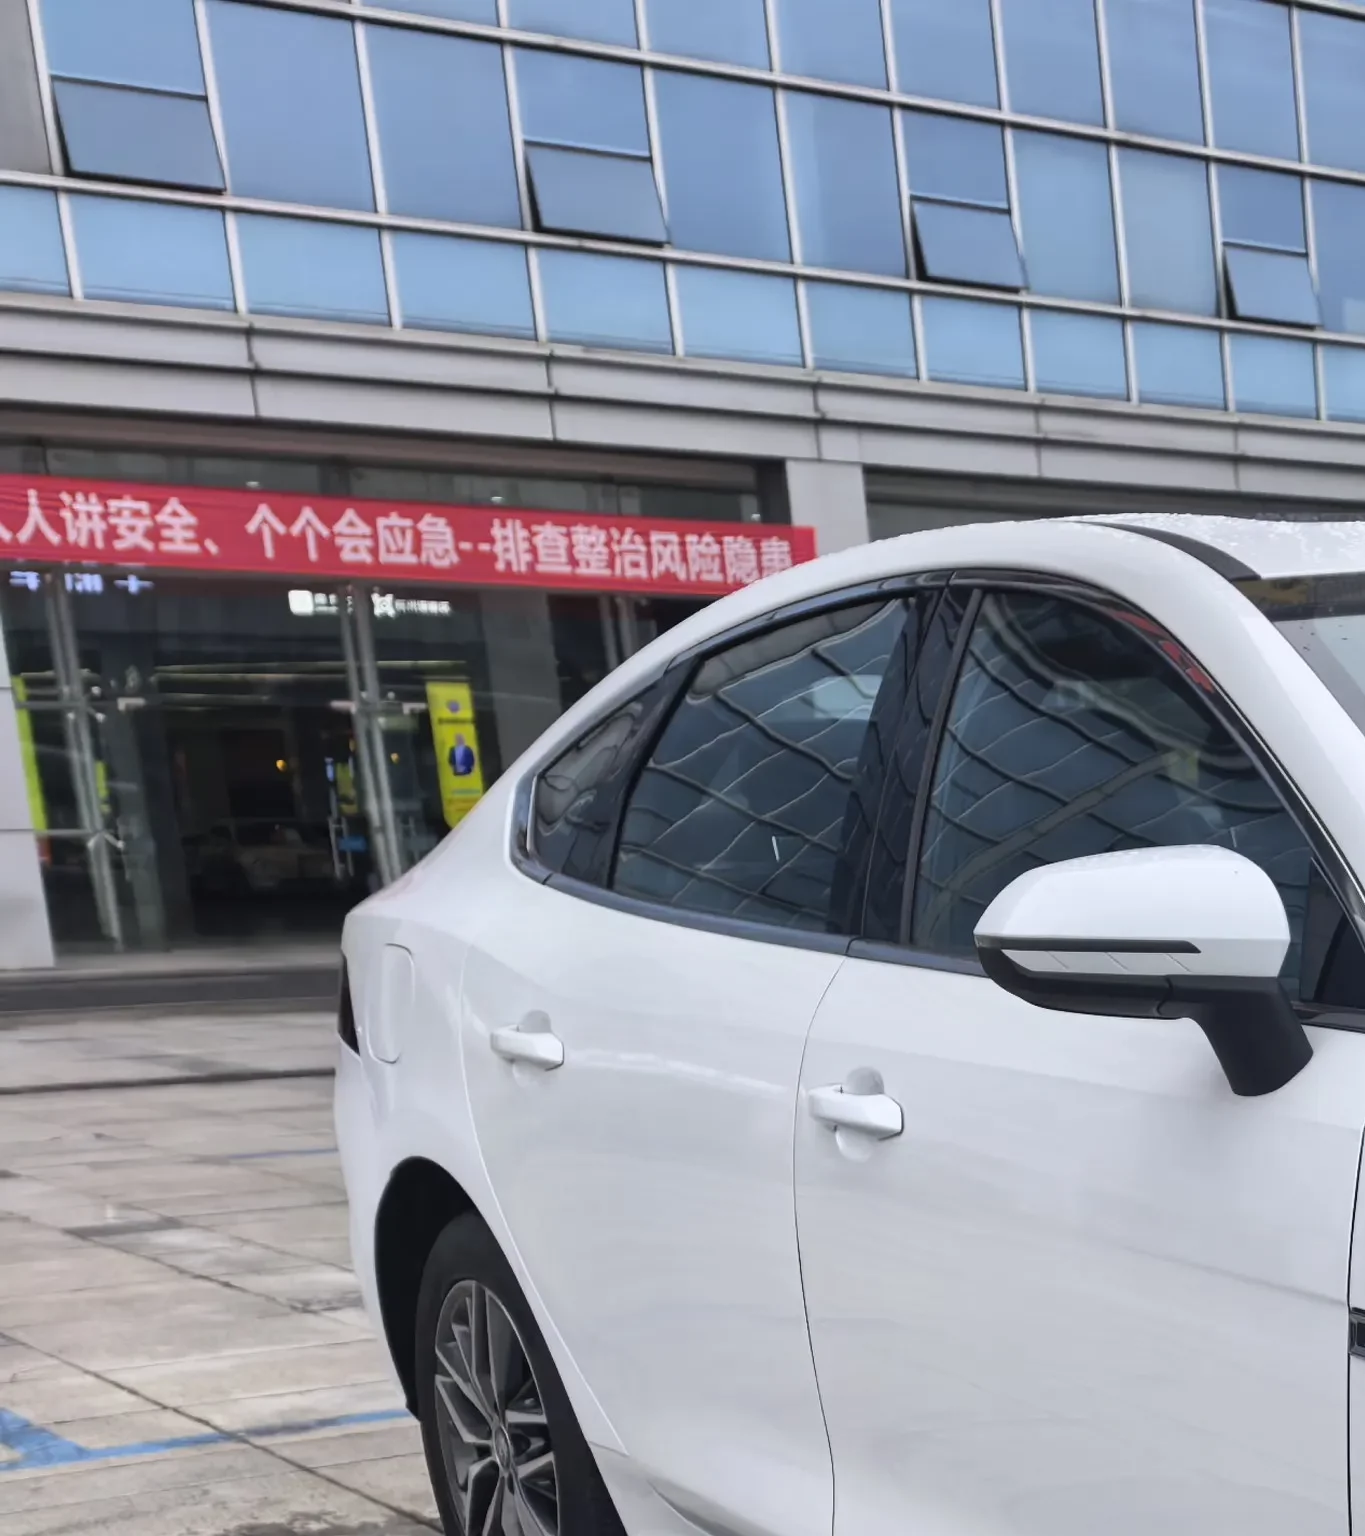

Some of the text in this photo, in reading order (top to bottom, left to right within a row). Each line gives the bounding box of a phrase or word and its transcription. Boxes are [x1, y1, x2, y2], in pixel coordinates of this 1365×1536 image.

[0, 488, 792, 584] 人讲安全、个个会应急--排查整治风险隐患
